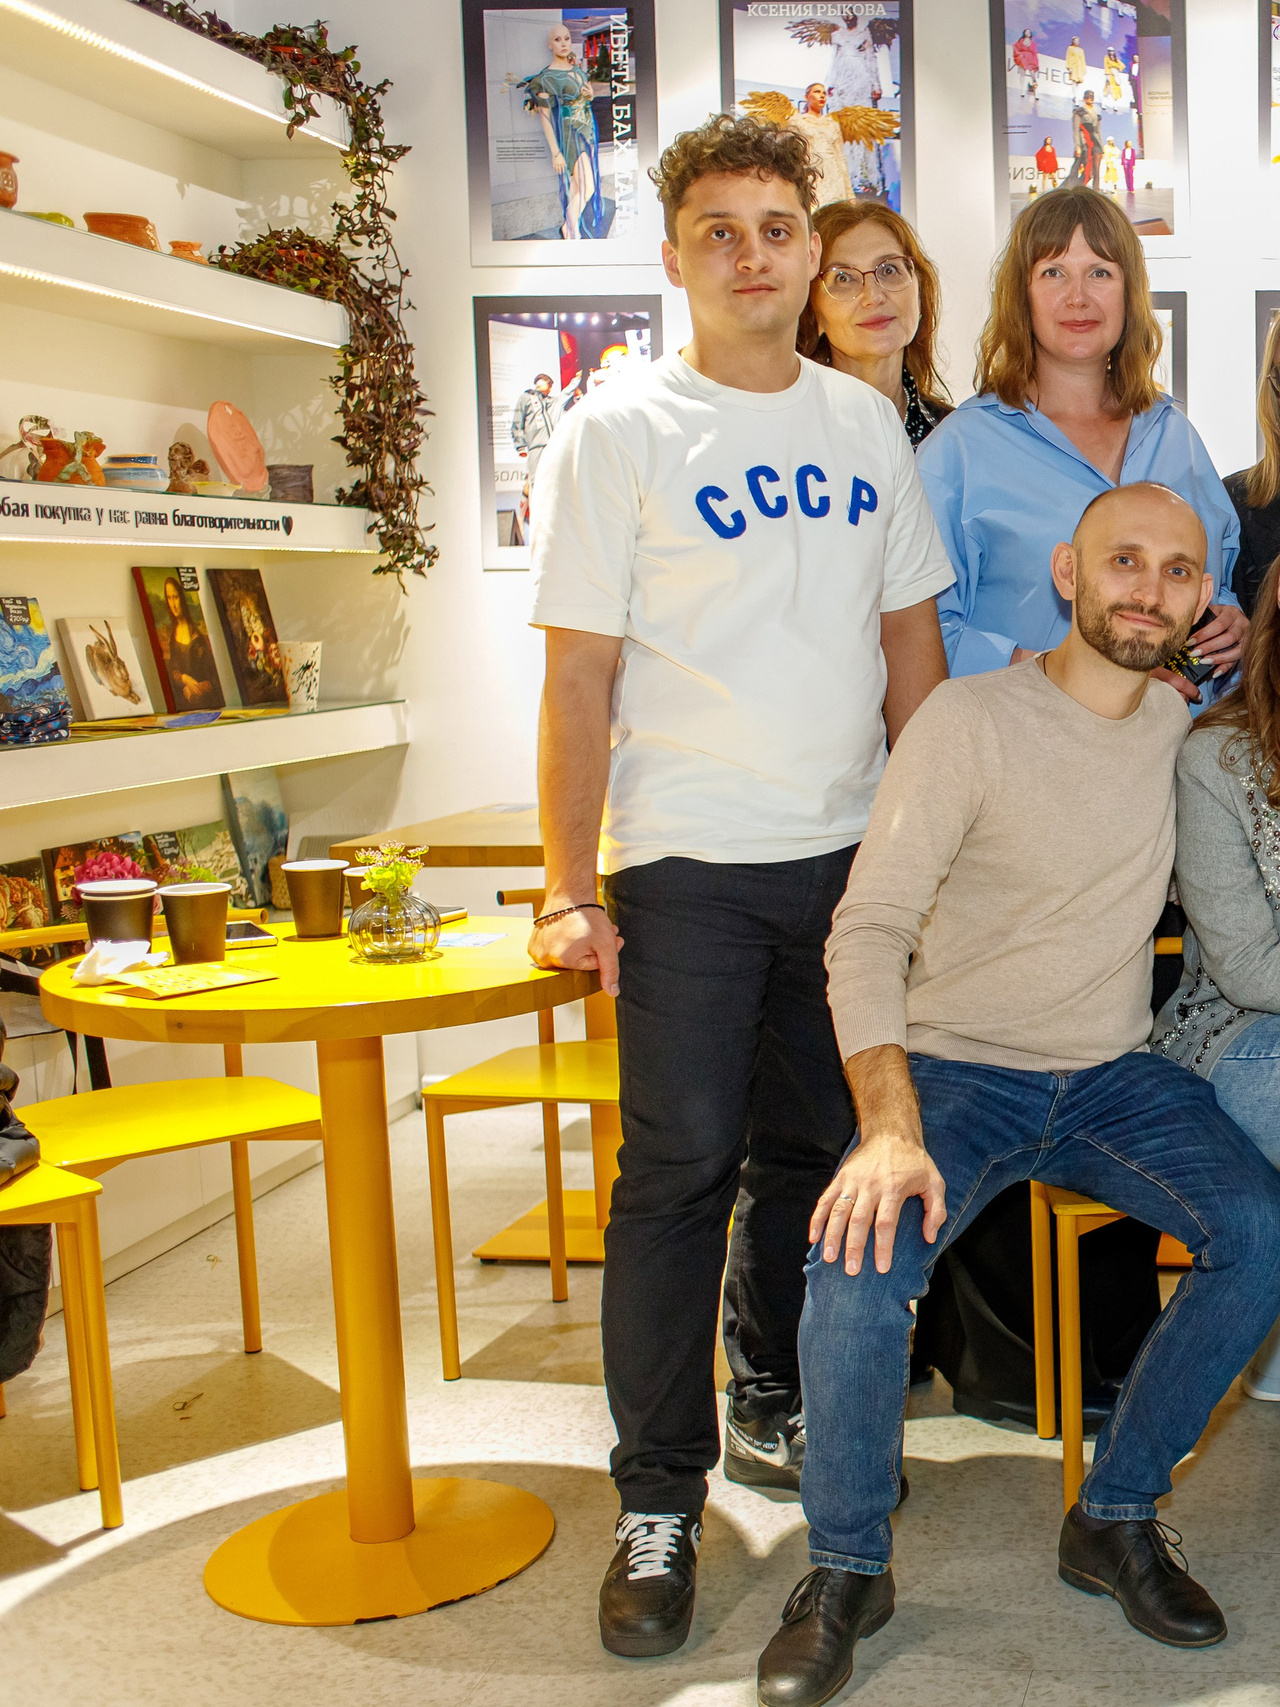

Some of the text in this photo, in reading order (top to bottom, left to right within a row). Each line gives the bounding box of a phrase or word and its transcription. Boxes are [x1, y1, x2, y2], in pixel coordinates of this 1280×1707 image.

[747, 3, 887, 17] КСЕНИЯ РЫКОВА
[609, 13, 632, 100] ИВЕТА
[1007, 57, 1073, 86] ИНЕС
[0, 496, 280, 532] бая покупка у нас равна благотворительности
[695, 464, 879, 540] СССР
